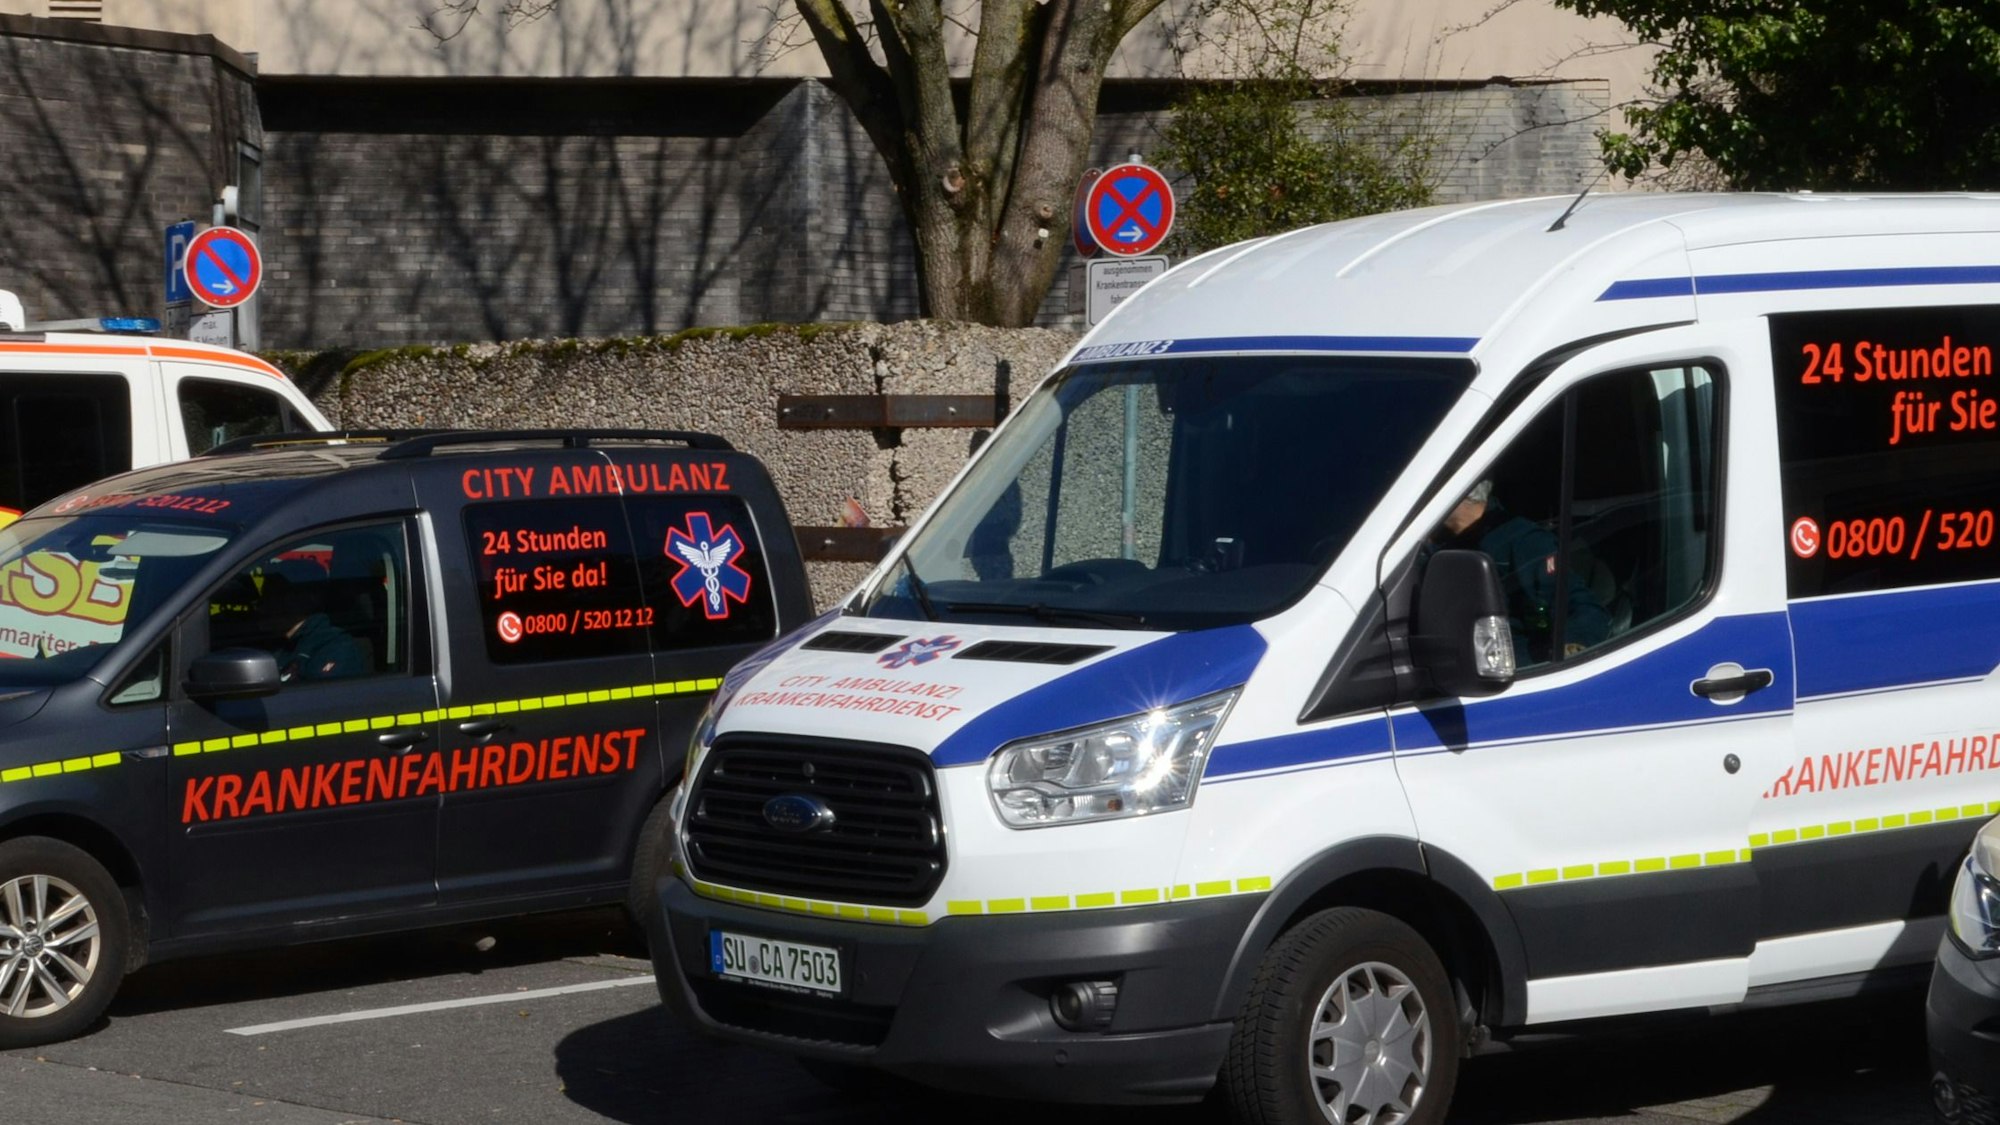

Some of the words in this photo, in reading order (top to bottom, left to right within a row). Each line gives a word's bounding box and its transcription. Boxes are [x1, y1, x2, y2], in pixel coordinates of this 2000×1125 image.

[172, 234, 186, 292] P
[1802, 343, 1844, 384] 24
[1854, 336, 1992, 382] Stunden
[1889, 391, 1940, 444] für
[1950, 389, 1997, 431] Sie
[461, 467, 535, 499] CITY
[549, 463, 731, 495] AMBULANZ
[482, 531, 511, 555] 24
[516, 526, 607, 553] Stunden
[1827, 516, 1905, 558] 0800
[1937, 510, 1994, 549] 520
[0, 534, 140, 626] SB
[494, 568, 528, 599] für
[533, 566, 566, 591] Sie
[571, 562, 608, 587] da!
[525, 613, 567, 635] 0800
[583, 610, 612, 630] 520
[614, 609, 632, 628] 12
[635, 607, 655, 626] 12
[779, 675, 828, 687] CITY
[735, 692, 961, 721] KRANKENFAHRDIENST
[181, 728, 646, 824] KRANKENFAHRDIENST
[723, 937, 746, 972] SU
[760, 943, 784, 978] CA
[788, 948, 837, 986] 7503
